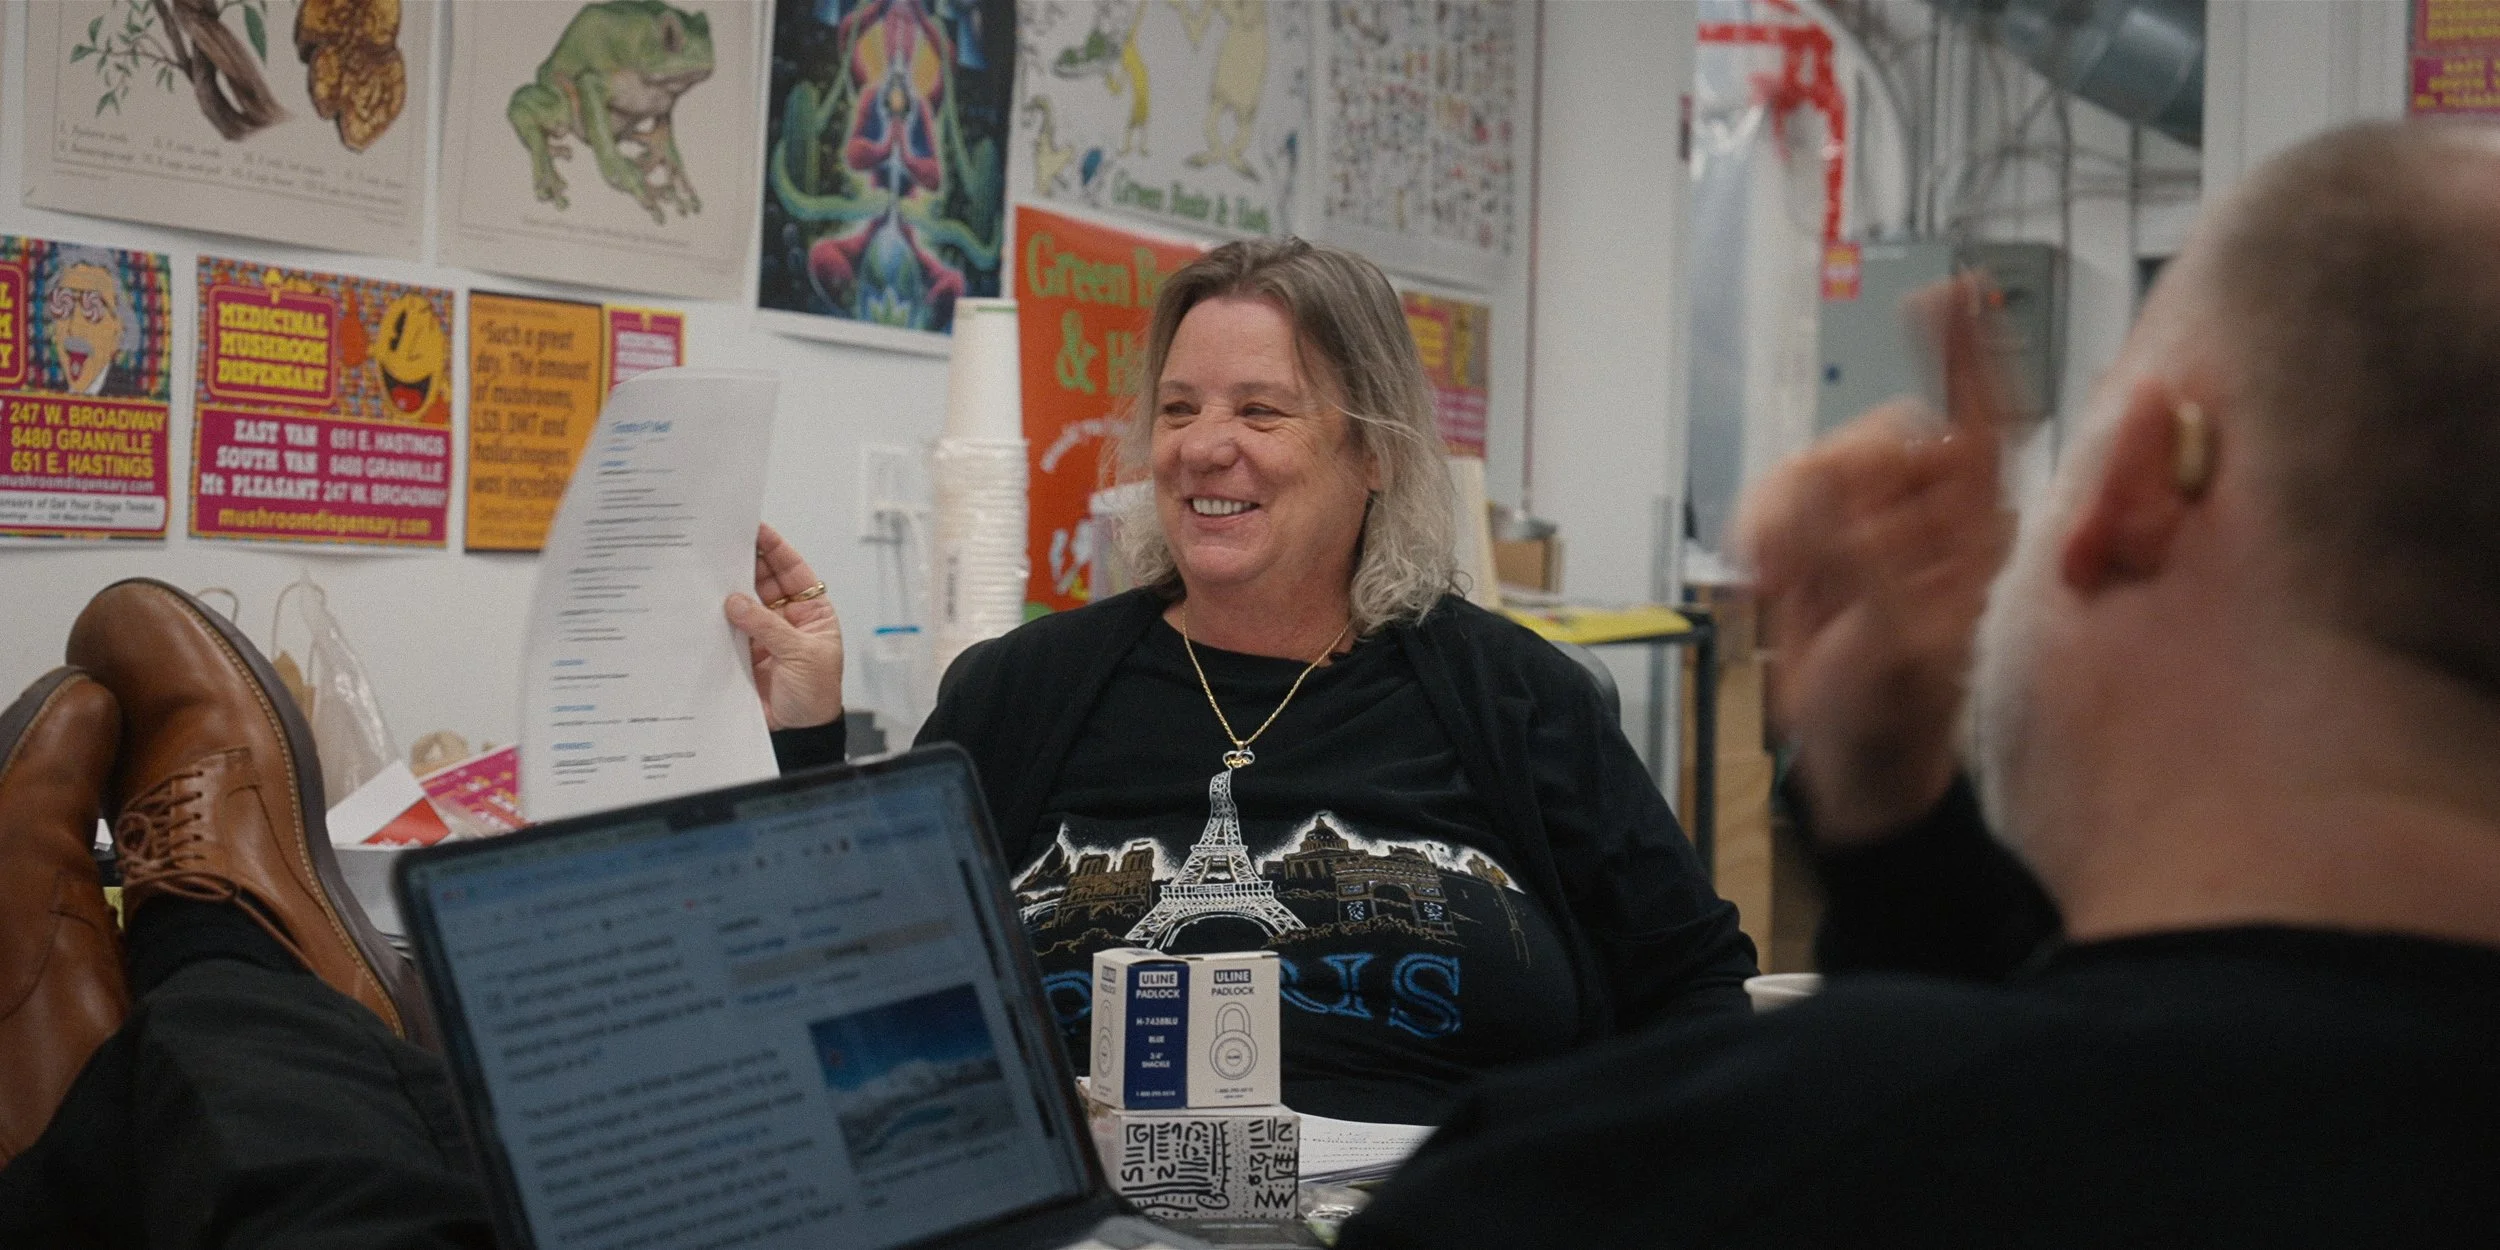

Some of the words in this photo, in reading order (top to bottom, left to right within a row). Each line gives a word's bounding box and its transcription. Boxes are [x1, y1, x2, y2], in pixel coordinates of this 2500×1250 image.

[1027, 231, 1131, 308] Green
[218, 301, 328, 338] MEDICINAL
[219, 330, 328, 365] MUSHROOM
[525, 329, 534, 346] a
[537, 329, 575, 354] great
[1056, 309, 1098, 396] &
[217, 358, 328, 393] DISPENSARY
[508, 351, 534, 377] The
[538, 360, 591, 382] amount
[475, 380, 490, 402] of
[9, 402, 39, 425] 247
[44, 403, 64, 426] W.
[68, 405, 167, 432] BROADWAY
[508, 410, 540, 435] DMT
[541, 415, 568, 438] and
[11, 426, 51, 451] 8480
[57, 428, 153, 455] GRANVILLE
[234, 418, 279, 444] EAST
[284, 423, 318, 448] VAN
[330, 428, 356, 449] 651
[358, 429, 373, 452] E.
[374, 431, 447, 457] HASTINGS
[11, 451, 41, 474] 651
[47, 452, 64, 475] E.
[68, 454, 155, 479] HASTINGS
[216, 445, 279, 471] SOUTH
[284, 450, 318, 474] VAN
[365, 456, 444, 483] GRANVILLE
[201, 472, 226, 496] Mt
[231, 474, 321, 502] PLEASANT
[322, 480, 348, 503] 247
[350, 483, 369, 504] W.
[371, 483, 447, 508] BROADWAY
[474, 476, 502, 494] was
[218, 507, 432, 538] mushroomdispensary.com
[1142, 974, 1176, 985] ULINE
[1214, 970, 1251, 983] ULINE
[1136, 989, 1180, 999] PADLOCK
[1211, 986, 1255, 997] PADLOCK
[1148, 1035, 1165, 1044] BLUE
[1141, 1060, 1171, 1068] SHACKLE
